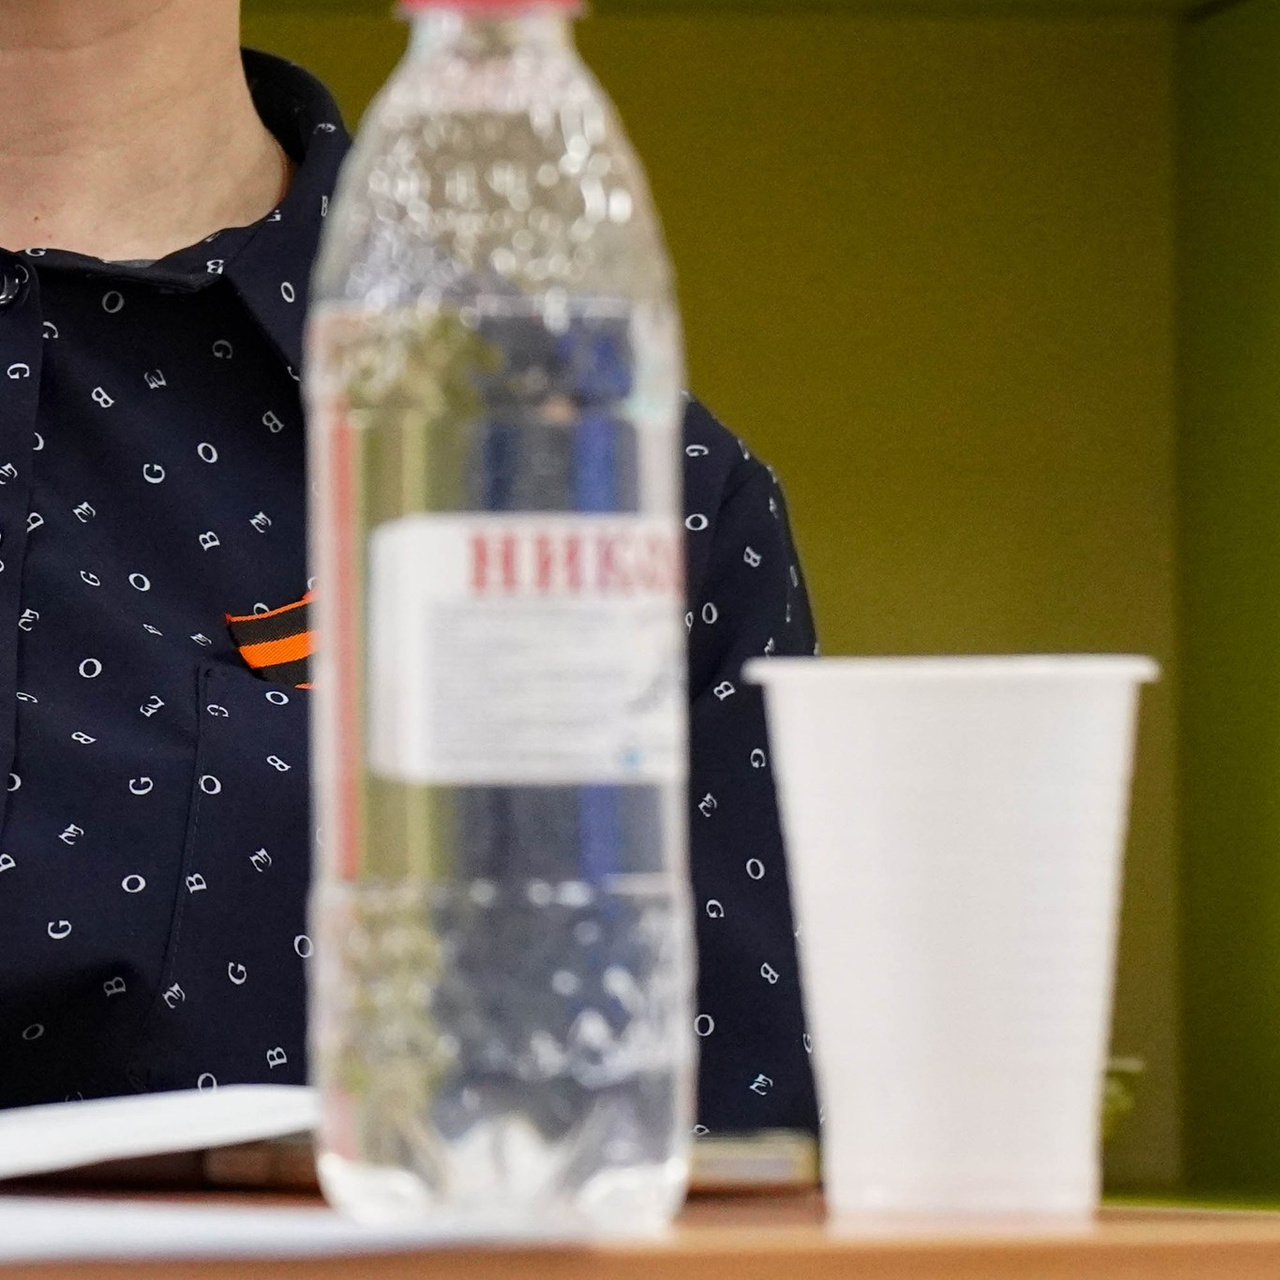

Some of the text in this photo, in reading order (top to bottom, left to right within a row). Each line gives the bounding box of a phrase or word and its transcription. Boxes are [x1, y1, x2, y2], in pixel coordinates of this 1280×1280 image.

[281, 282, 295, 303] O
[91, 387, 115, 408] B
[197, 442, 218, 463] O
[687, 514, 708, 531] O
[199, 531, 220, 551] B
[128, 573, 150, 591] O
[702, 602, 718, 624] O
[79, 658, 102, 678] O
[265, 691, 289, 705] O
[713, 681, 736, 701] B
[71, 732, 97, 744] B
[267, 755, 291, 771] B
[198, 775, 221, 794] O
[746, 858, 765, 880] O
[121, 875, 146, 893] O
[185, 873, 207, 893] B
[760, 962, 779, 984] B
[695, 1014, 714, 1036] O
[266, 1047, 287, 1069] B
